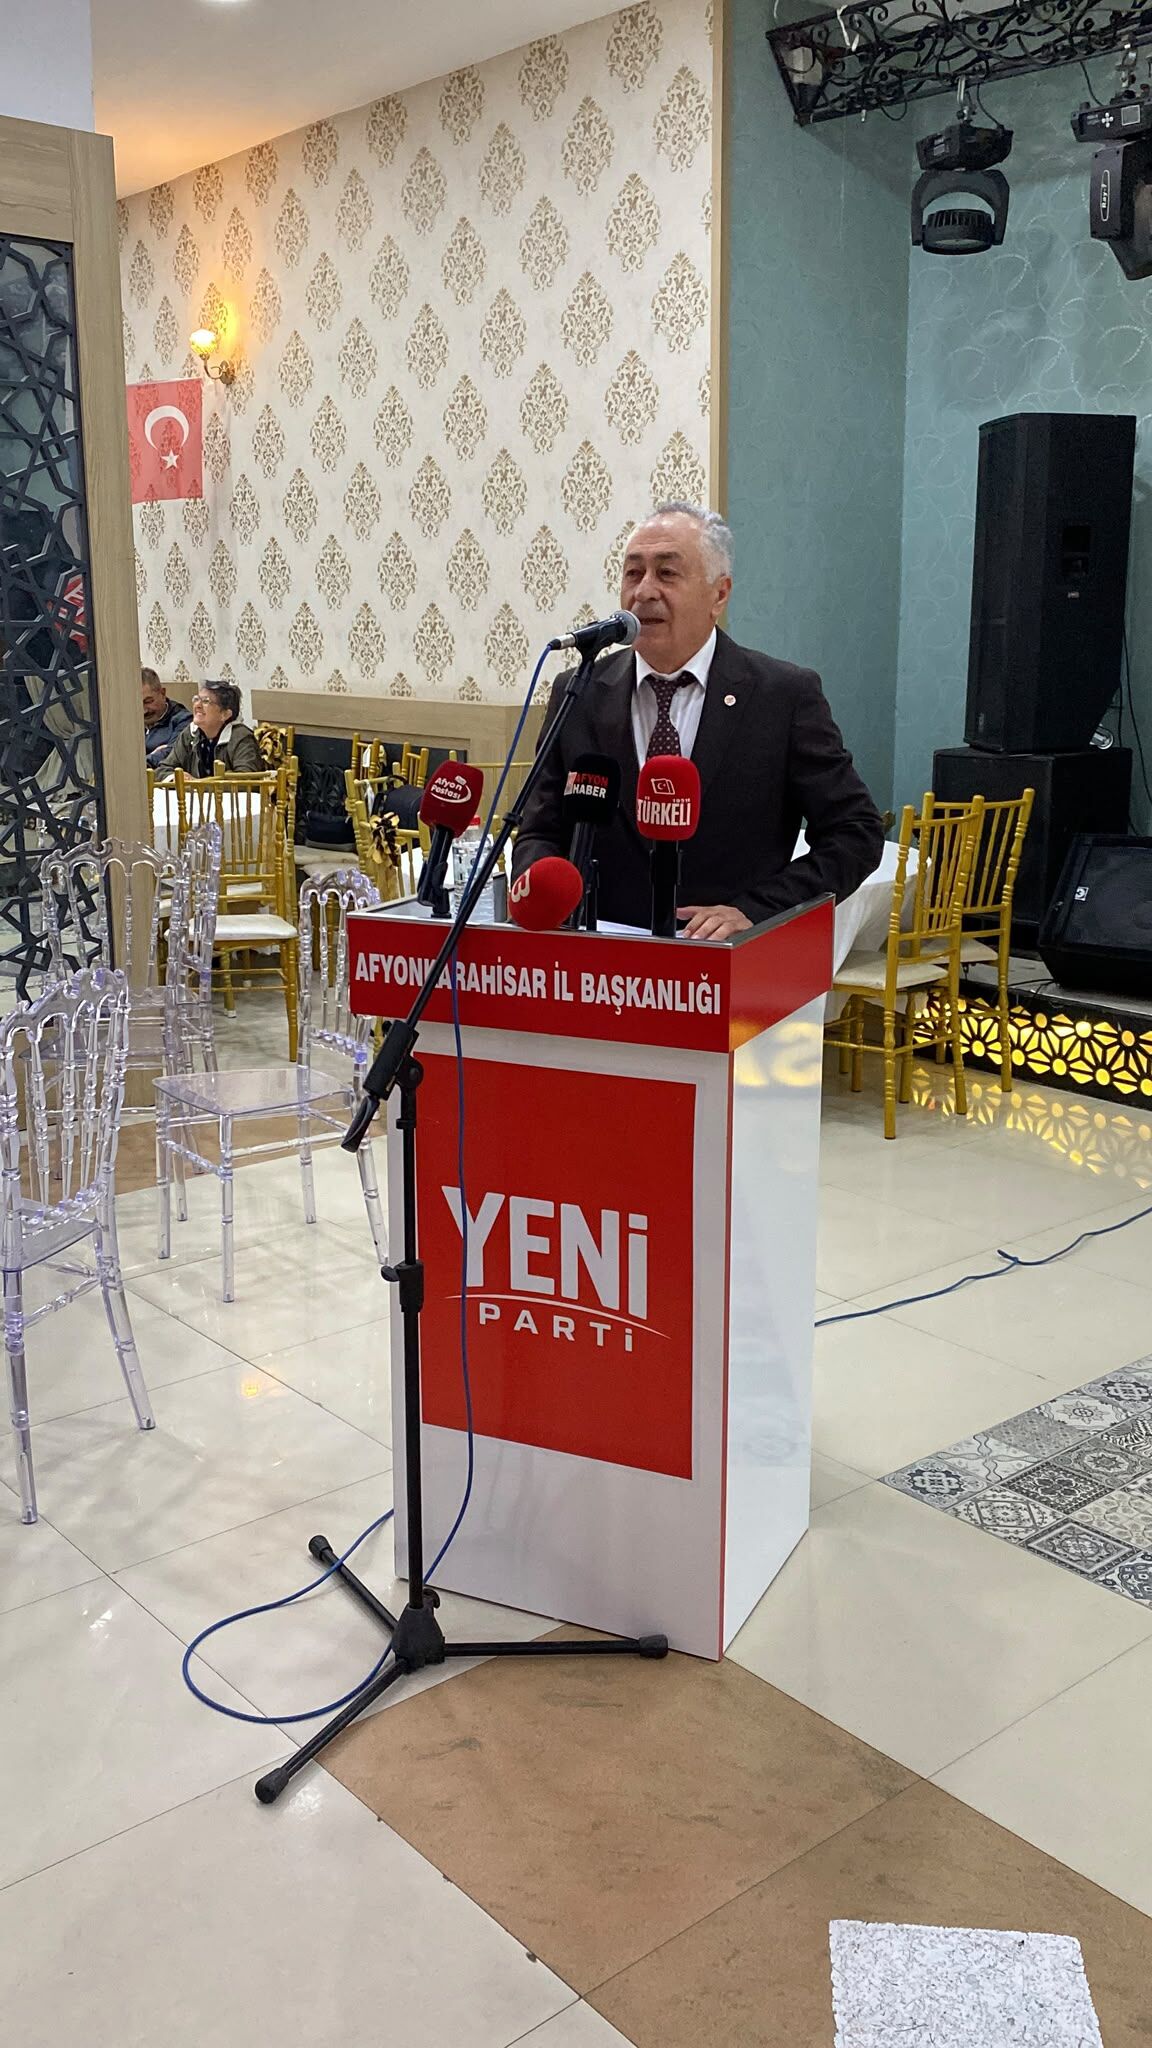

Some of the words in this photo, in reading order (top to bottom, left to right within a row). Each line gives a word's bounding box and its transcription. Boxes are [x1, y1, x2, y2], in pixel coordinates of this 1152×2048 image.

[434, 777, 463, 791] Afyon
[572, 783, 607, 799] HABER
[553, 961, 574, 1002] İL
[580, 972, 721, 1016] BAŞKANLIĞI
